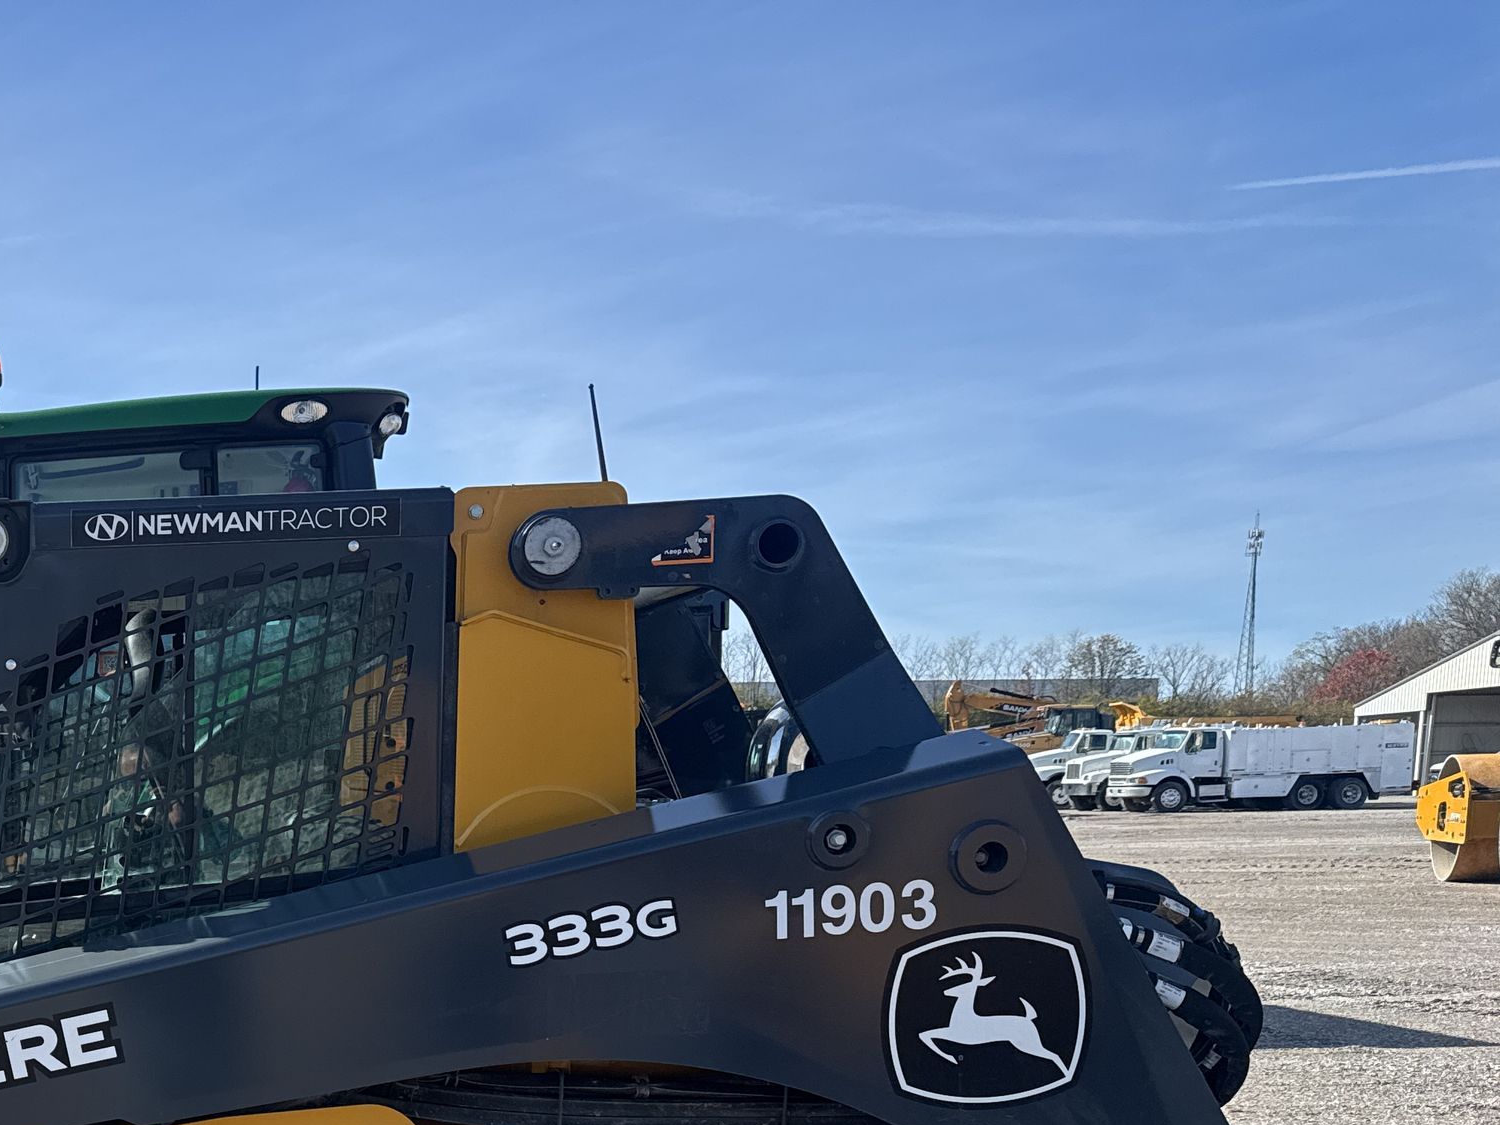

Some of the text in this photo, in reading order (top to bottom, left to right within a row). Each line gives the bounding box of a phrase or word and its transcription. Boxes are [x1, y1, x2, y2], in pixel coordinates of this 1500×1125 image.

[138, 505, 388, 537] NEWMANTRACTOR
[504, 899, 678, 966] 333G
[764, 879, 938, 940] 11903
